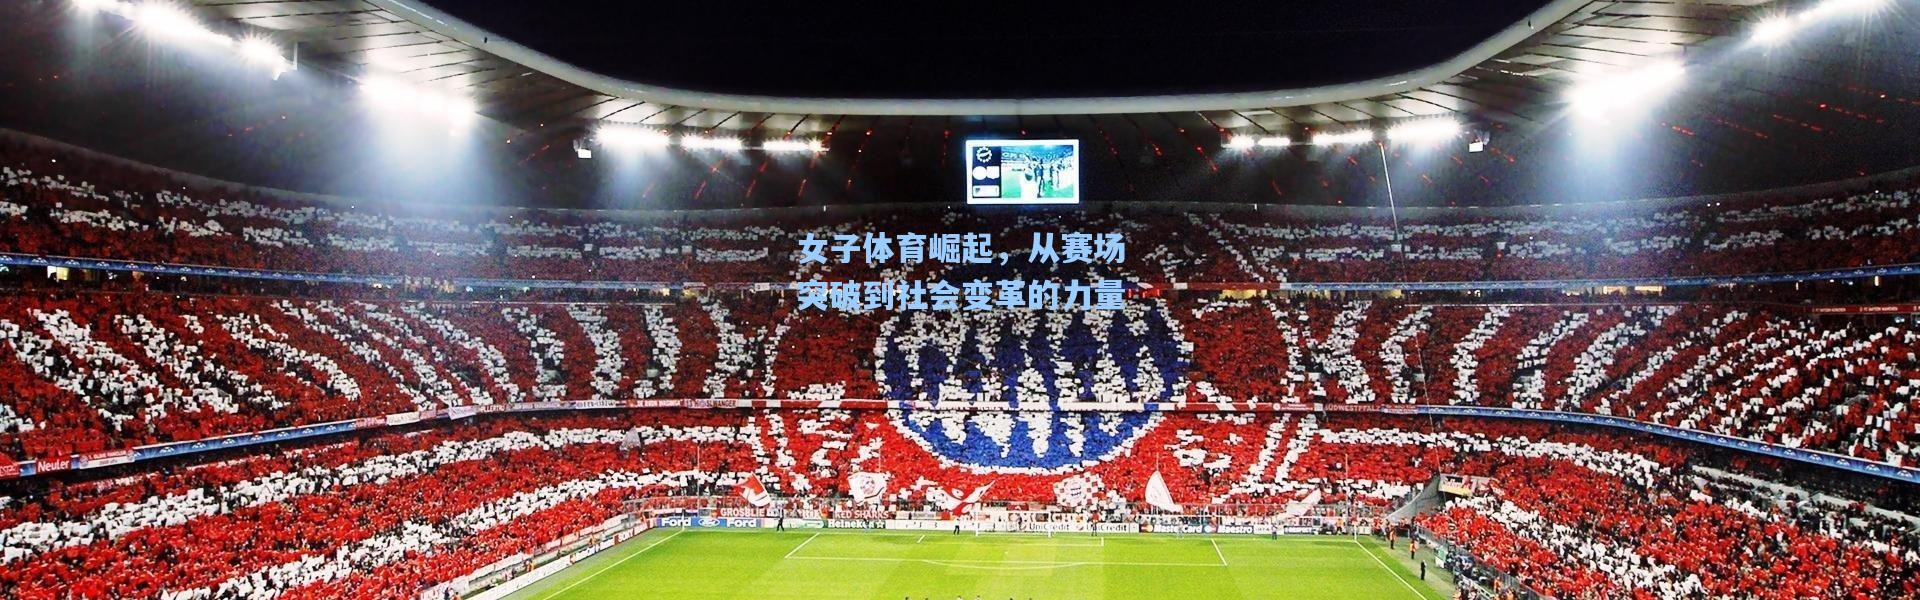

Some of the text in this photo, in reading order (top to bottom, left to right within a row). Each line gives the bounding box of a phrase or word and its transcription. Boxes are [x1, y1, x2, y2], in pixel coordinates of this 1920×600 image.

[38, 460, 70, 473] Neuler
[661, 517, 692, 527] Ford
[727, 517, 757, 528] Ford
[1029, 523, 1070, 532] UniCredit
